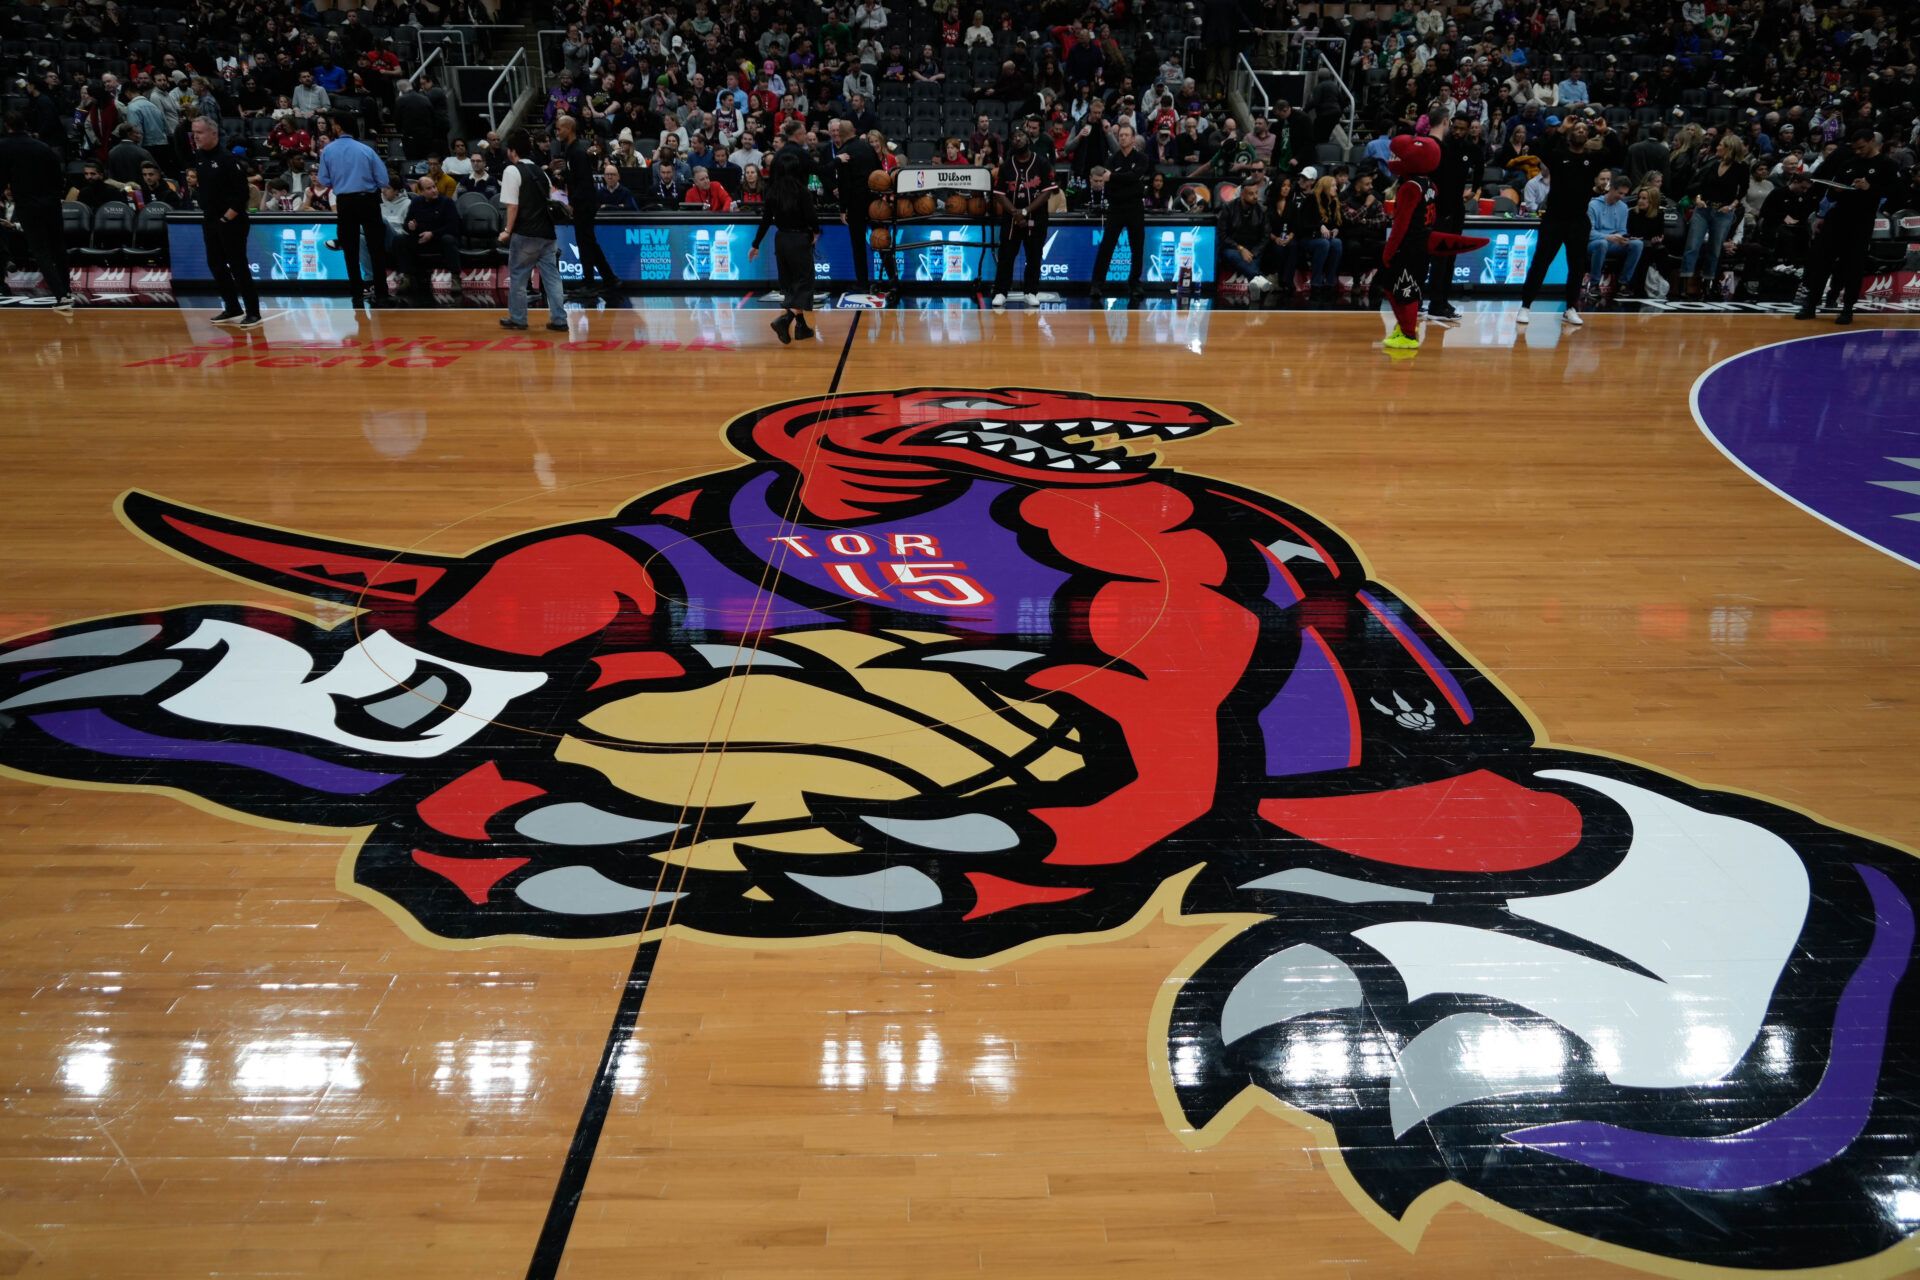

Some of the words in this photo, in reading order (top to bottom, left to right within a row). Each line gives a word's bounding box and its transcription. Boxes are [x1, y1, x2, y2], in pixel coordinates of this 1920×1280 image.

[937, 172, 972, 182] Wilson
[625, 229, 669, 244] NEW
[641, 271, 671, 279] BODY
[1040, 264, 1069, 276] gree
[185, 336, 737, 351] Scotiabank
[121, 352, 462, 368] Arena
[768, 533, 943, 558] TOR
[822, 561, 995, 608] 15
